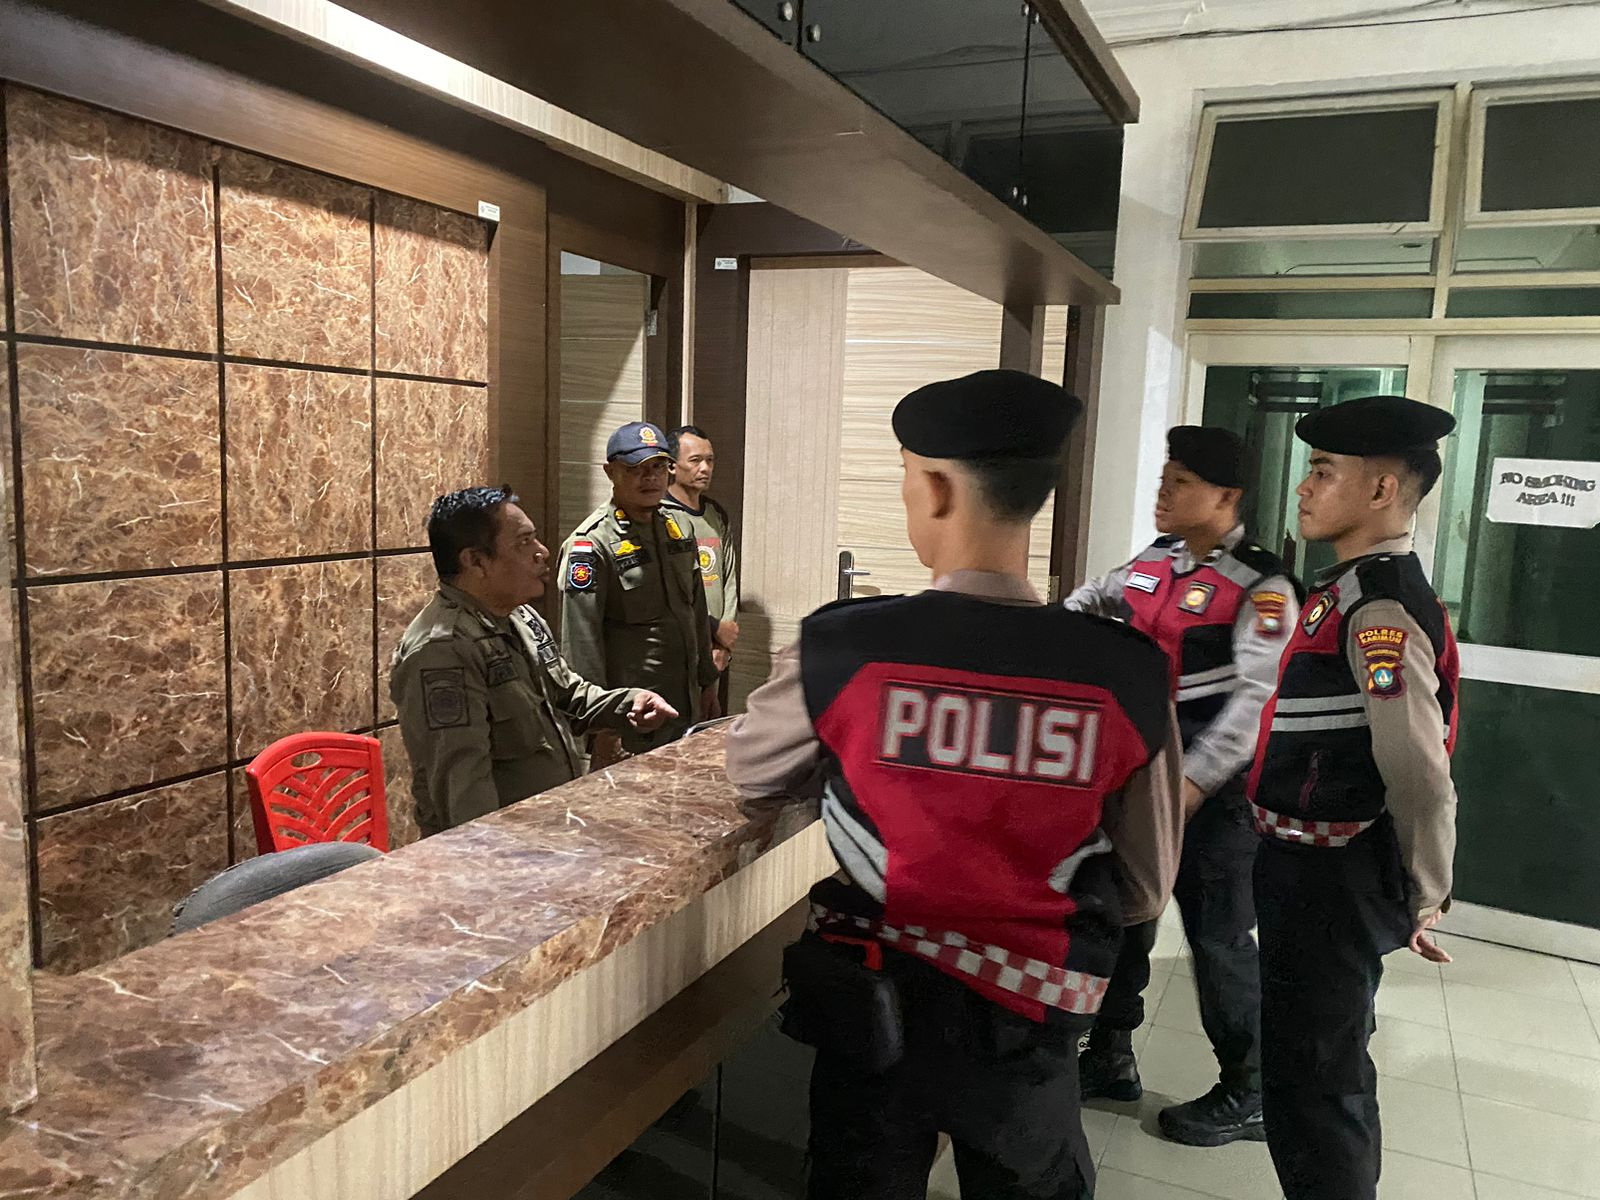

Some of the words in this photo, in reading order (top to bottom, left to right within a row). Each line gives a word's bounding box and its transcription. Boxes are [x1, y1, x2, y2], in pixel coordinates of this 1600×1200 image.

[1499, 472, 1523, 485] NO
[1524, 474, 1595, 491] SMOKING
[1516, 492, 1558, 505] AREA
[1358, 629, 1404, 640] POLRES
[882, 687, 1099, 782] POLISI
